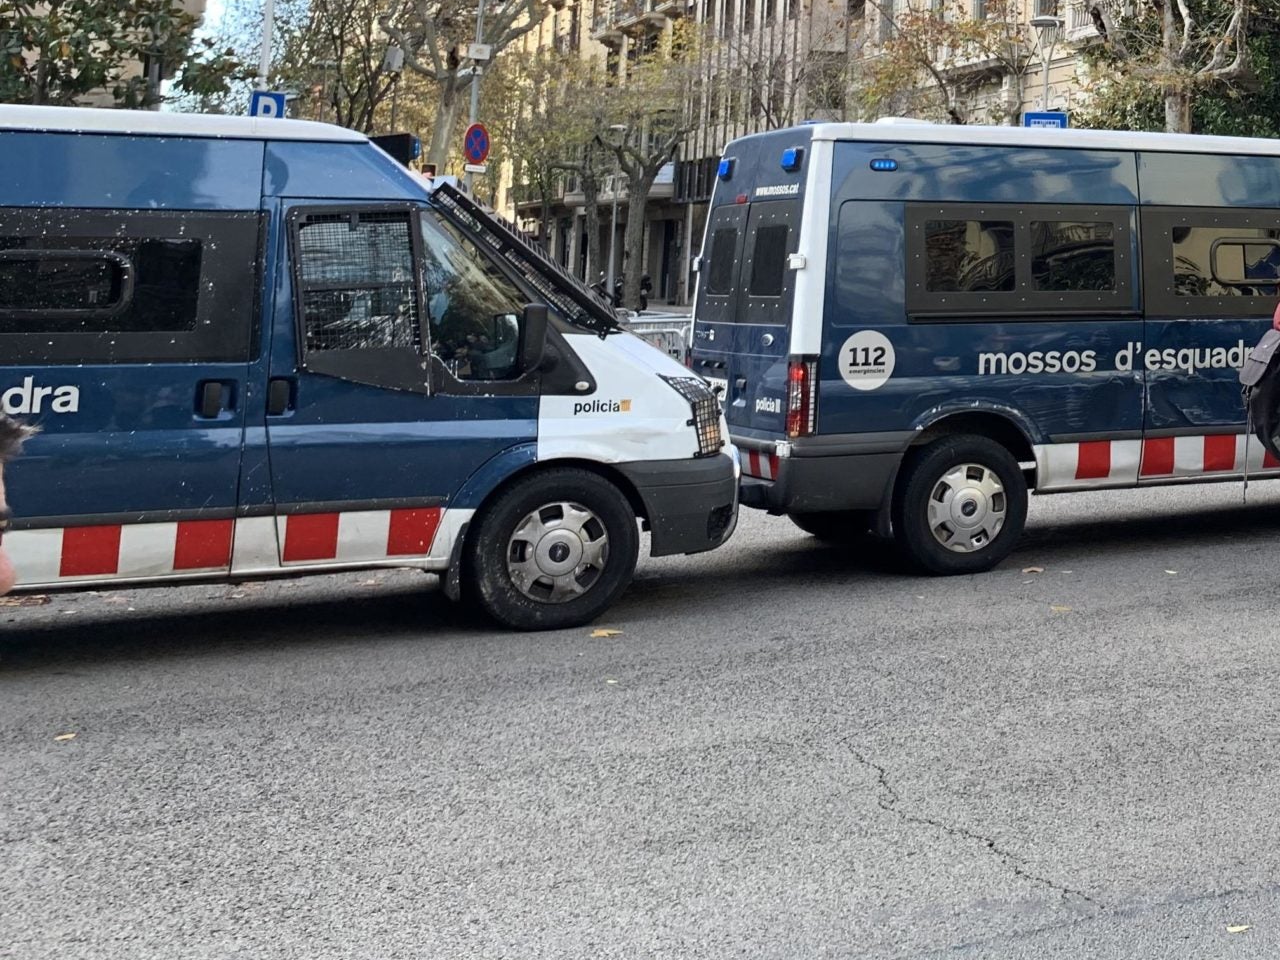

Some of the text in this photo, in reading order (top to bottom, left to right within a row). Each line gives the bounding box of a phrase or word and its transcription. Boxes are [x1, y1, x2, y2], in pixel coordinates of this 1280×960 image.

[755, 183, 800, 196] www.mossos.cat
[849, 346, 886, 367] 112
[978, 349, 1097, 375] mossos
[1, 375, 80, 415] dra
[574, 400, 620, 416] policia
[755, 397, 776, 413] policia
